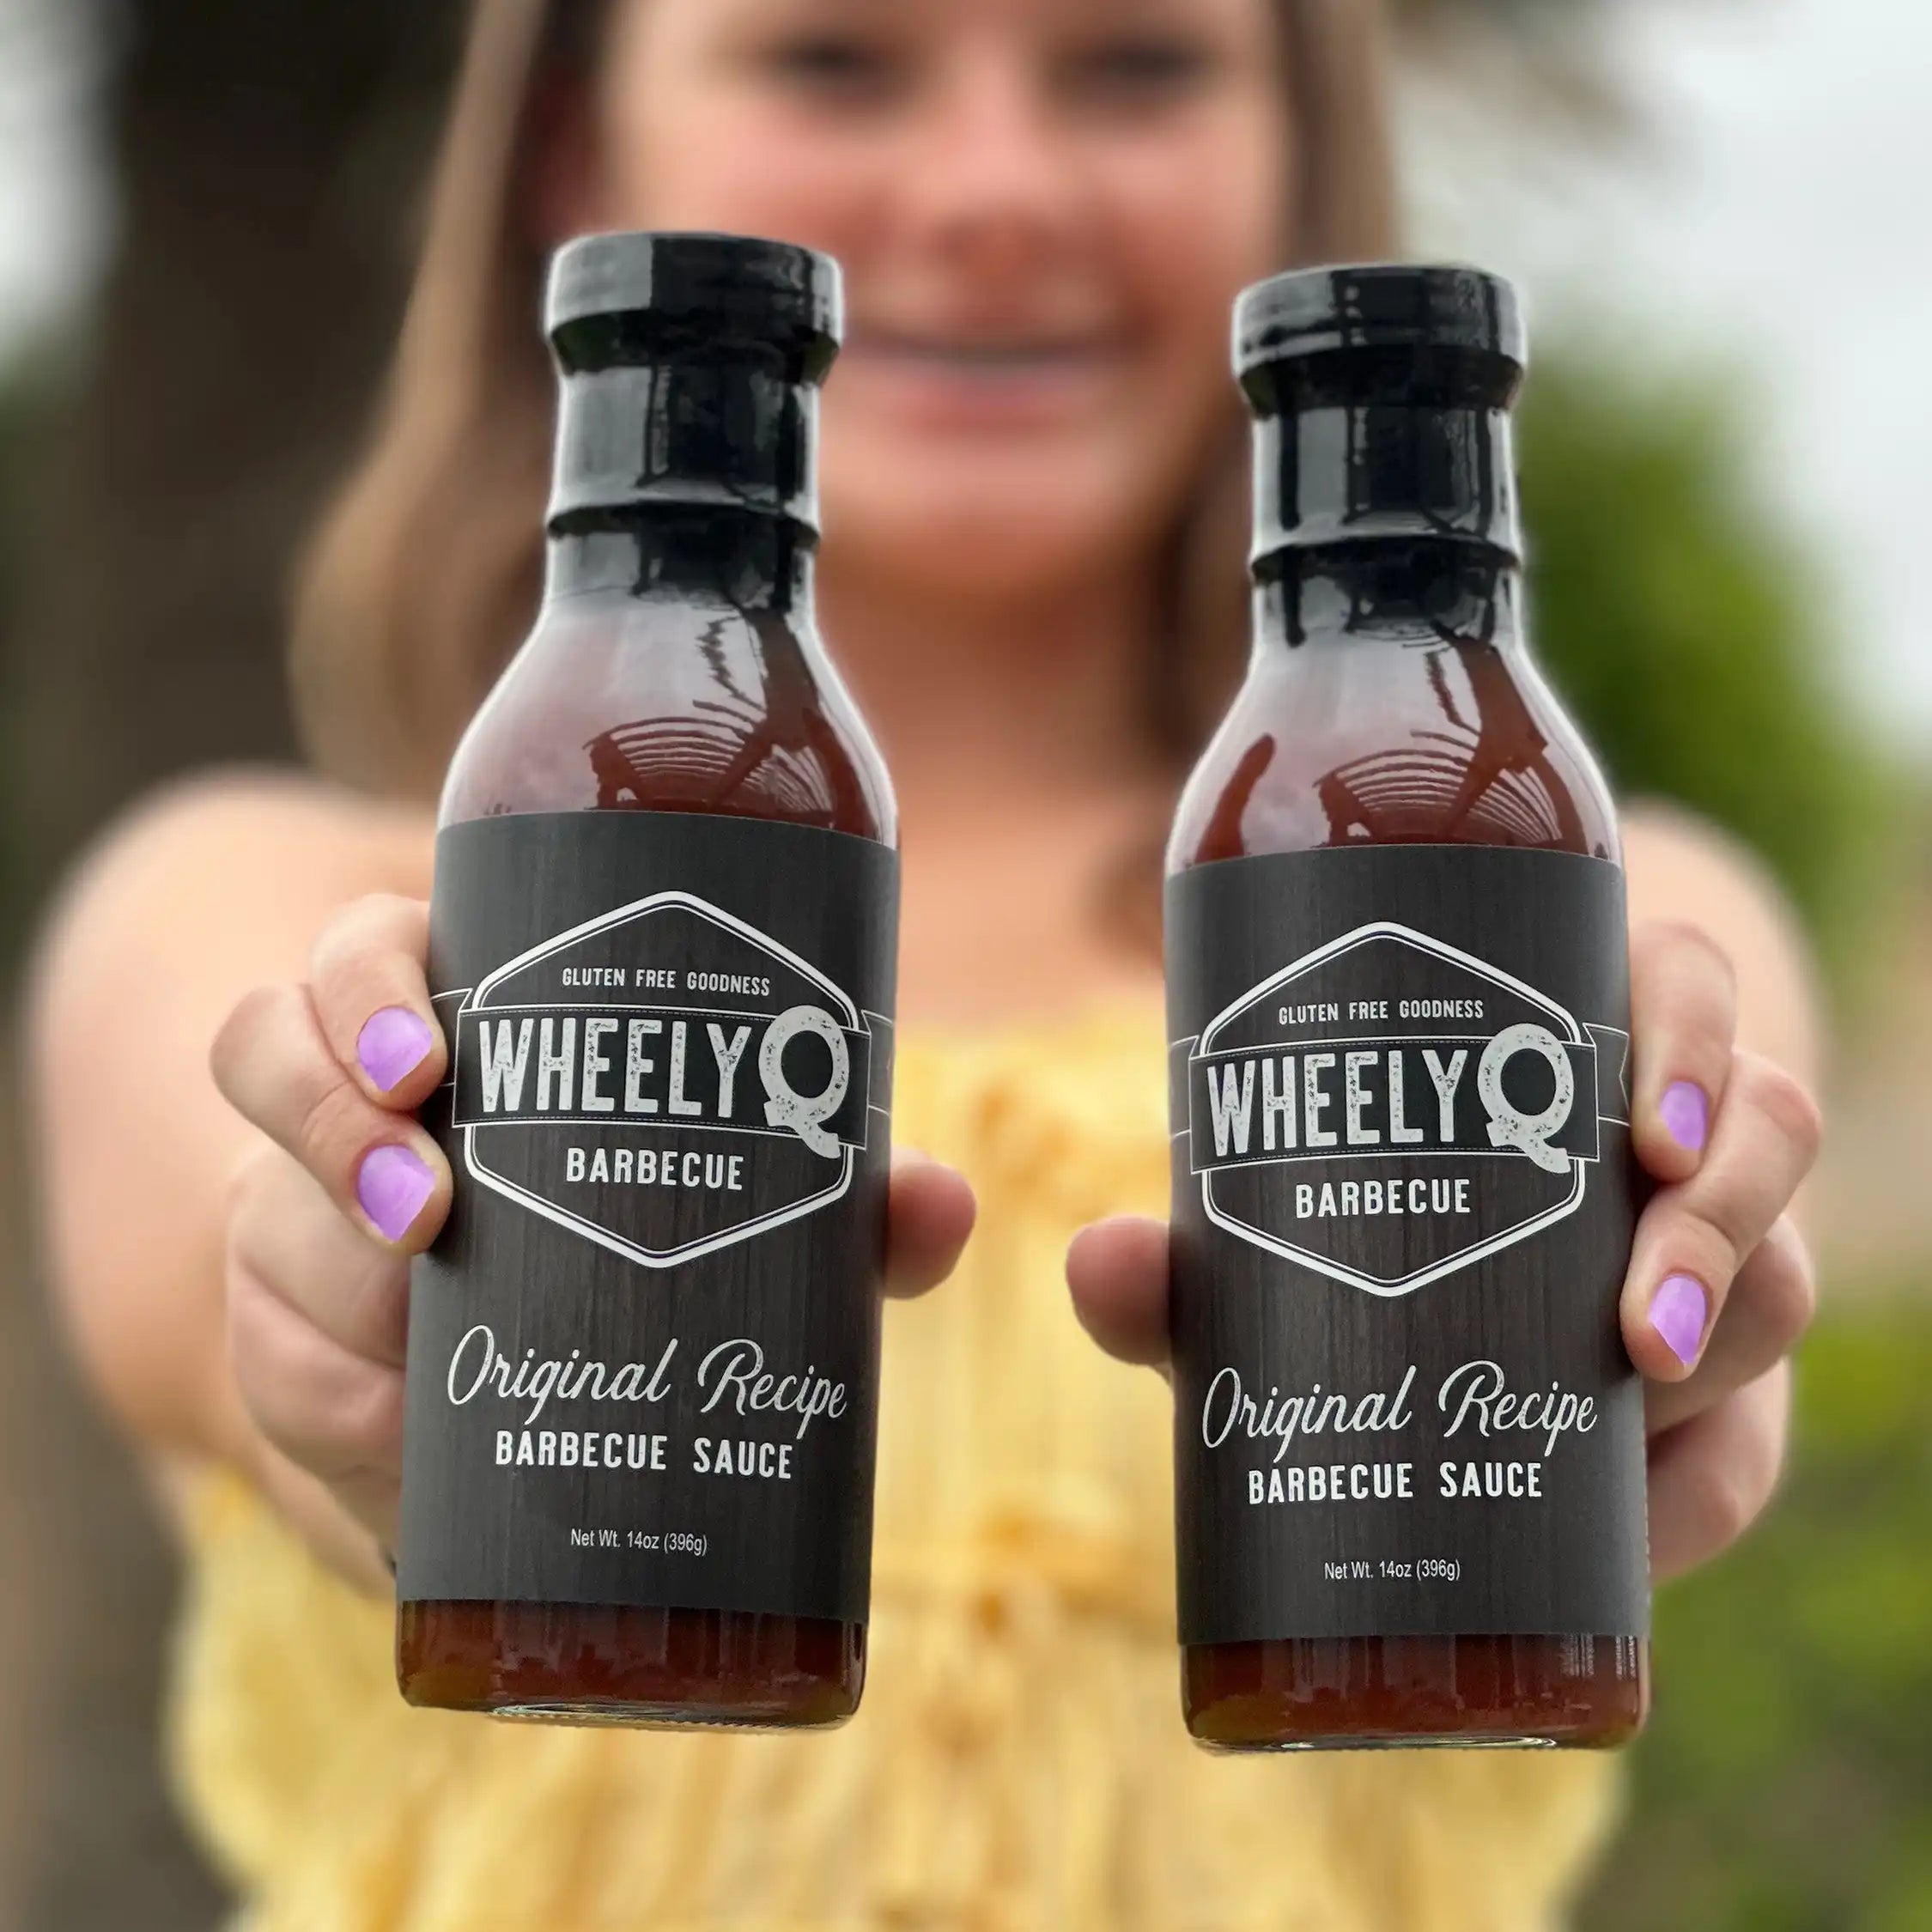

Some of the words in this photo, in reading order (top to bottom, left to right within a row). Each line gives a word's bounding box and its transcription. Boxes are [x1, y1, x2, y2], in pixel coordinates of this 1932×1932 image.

[562, 967, 625, 987] GLUTEN
[635, 969, 677, 989] FREE
[686, 971, 770, 997] GOODNESS
[1278, 1002, 1339, 1025] GLUTEN
[1349, 1000, 1388, 1020] FREE
[1399, 999, 1484, 1019] GOODNESS
[566, 1147, 744, 1191] BARBECUE
[1296, 1178, 1471, 1219] BARBECUE
[447, 1324, 678, 1425] Original
[695, 1337, 848, 1440] Recipe
[1203, 1364, 1417, 1463] Original
[1437, 1360, 1598, 1457] Recipe
[495, 1430, 668, 1470] BARBECUE
[693, 1437, 793, 1479] SAUCE
[1249, 1461, 1413, 1505] BARBECUE
[1439, 1461, 1542, 1498] SAUCE
[571, 1528, 595, 1546] Net
[598, 1529, 621, 1547] Wt.
[627, 1530, 660, 1550] 14oz
[664, 1532, 708, 1557] (396g)
[1324, 1562, 1348, 1580] Net
[1351, 1560, 1374, 1579] Wt.
[1379, 1560, 1413, 1578] 14oz
[1416, 1558, 1461, 1582] (396g)
